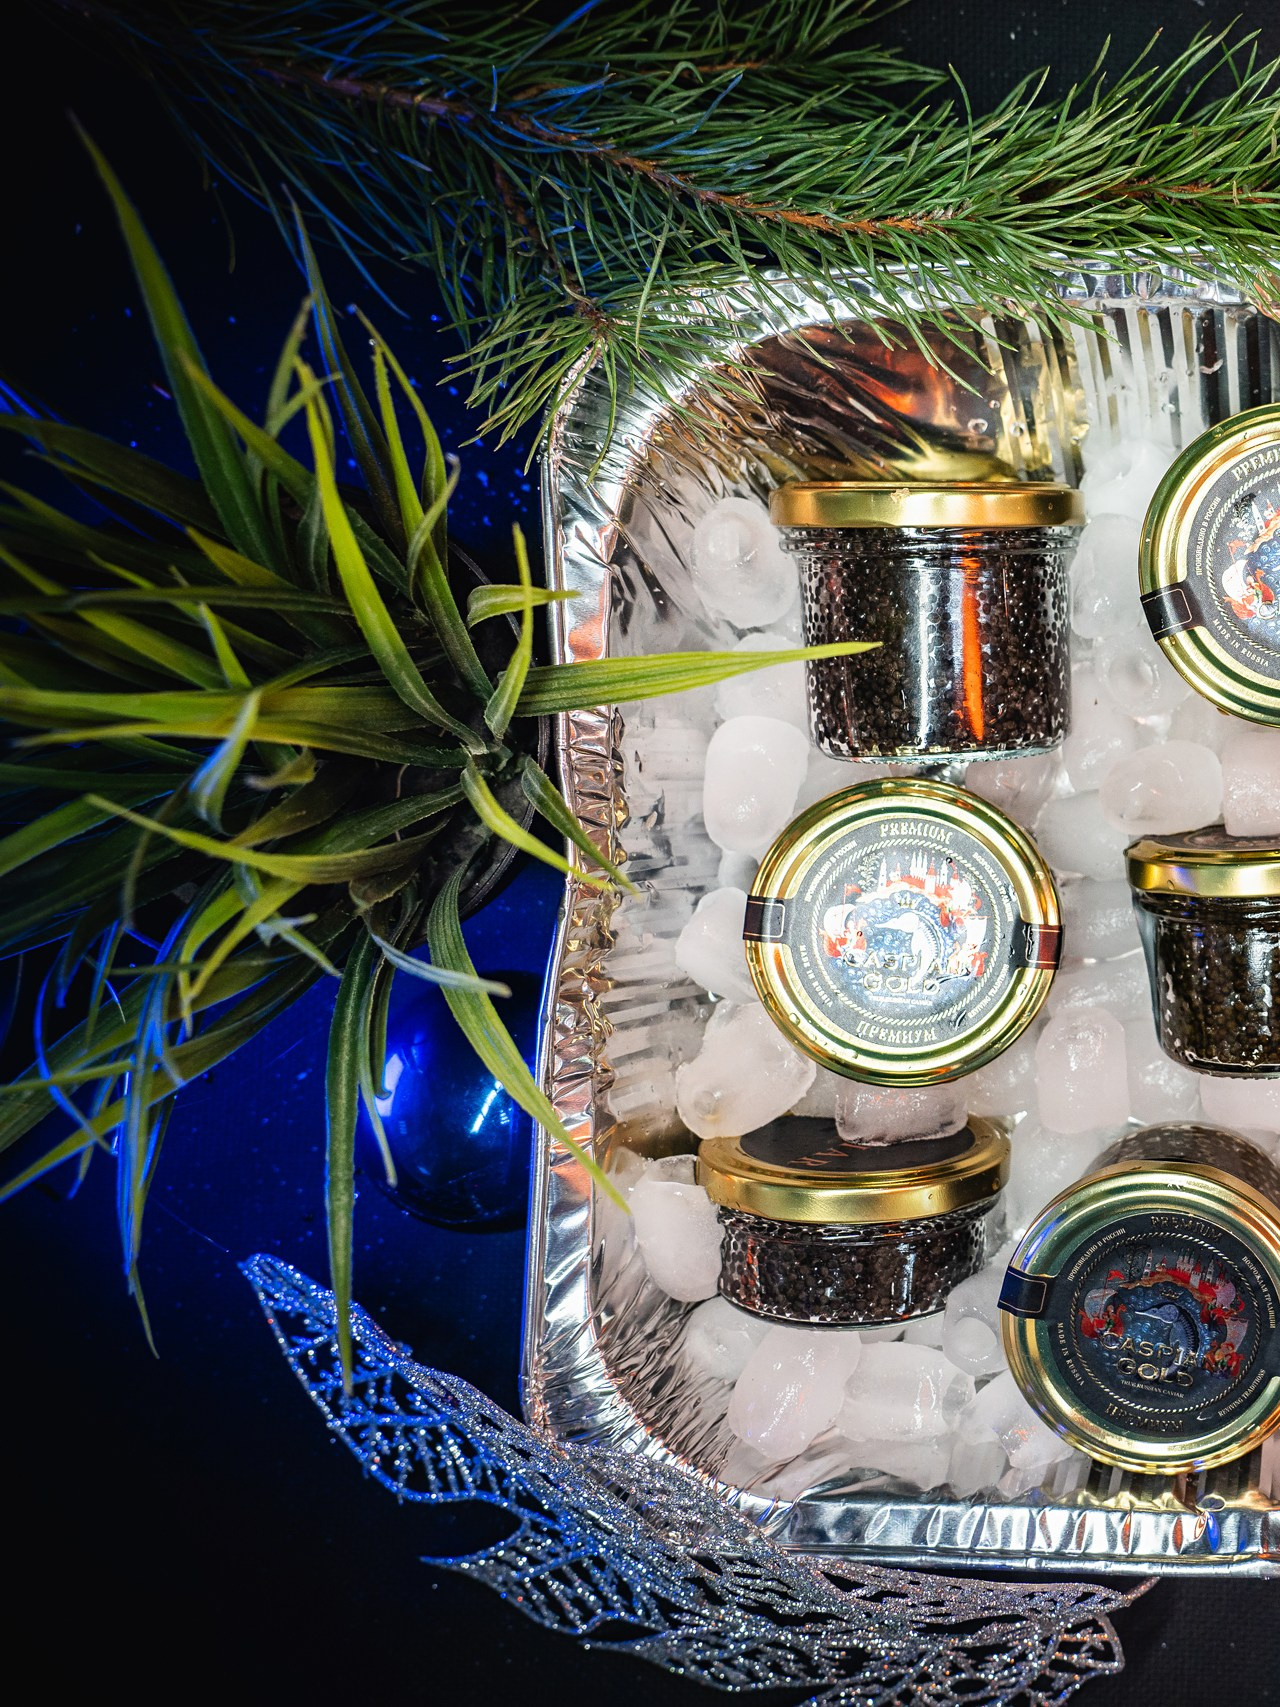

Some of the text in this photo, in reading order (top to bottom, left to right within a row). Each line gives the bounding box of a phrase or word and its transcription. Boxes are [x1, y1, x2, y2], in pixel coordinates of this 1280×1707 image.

[1195, 496, 1222, 576] ПРОИЗВЕДЕНО В РОССИИ
[1212, 618, 1269, 667] MADE IN RUSSIA
[880, 821, 954, 844] PREMIUM
[800, 944, 833, 1008] MADE IN RUSSIA
[843, 949, 972, 976] CASPIAN
[863, 971, 940, 995] GOLD
[967, 963, 1010, 1018] REVIVING TRADITIONS
[856, 1020, 938, 1044] ПРЕМИУМ
[1151, 1215, 1223, 1241] PREMIUM
[1067, 1227, 1126, 1282] ПРОИЗВЕДЕНО В РОССИИ
[1241, 1255, 1276, 1328] ВОЗРОЖДАЯ ТРАДИЦИИ
[1057, 1322, 1085, 1386] MADE IN RUSSIA
[1100, 1331, 1217, 1373] CASPIAN
[1116, 1357, 1194, 1387] GOLD
[1162, 1389, 1185, 1398] CAVIAR
[1217, 1369, 1266, 1417] REVIVING TRADITIONS
